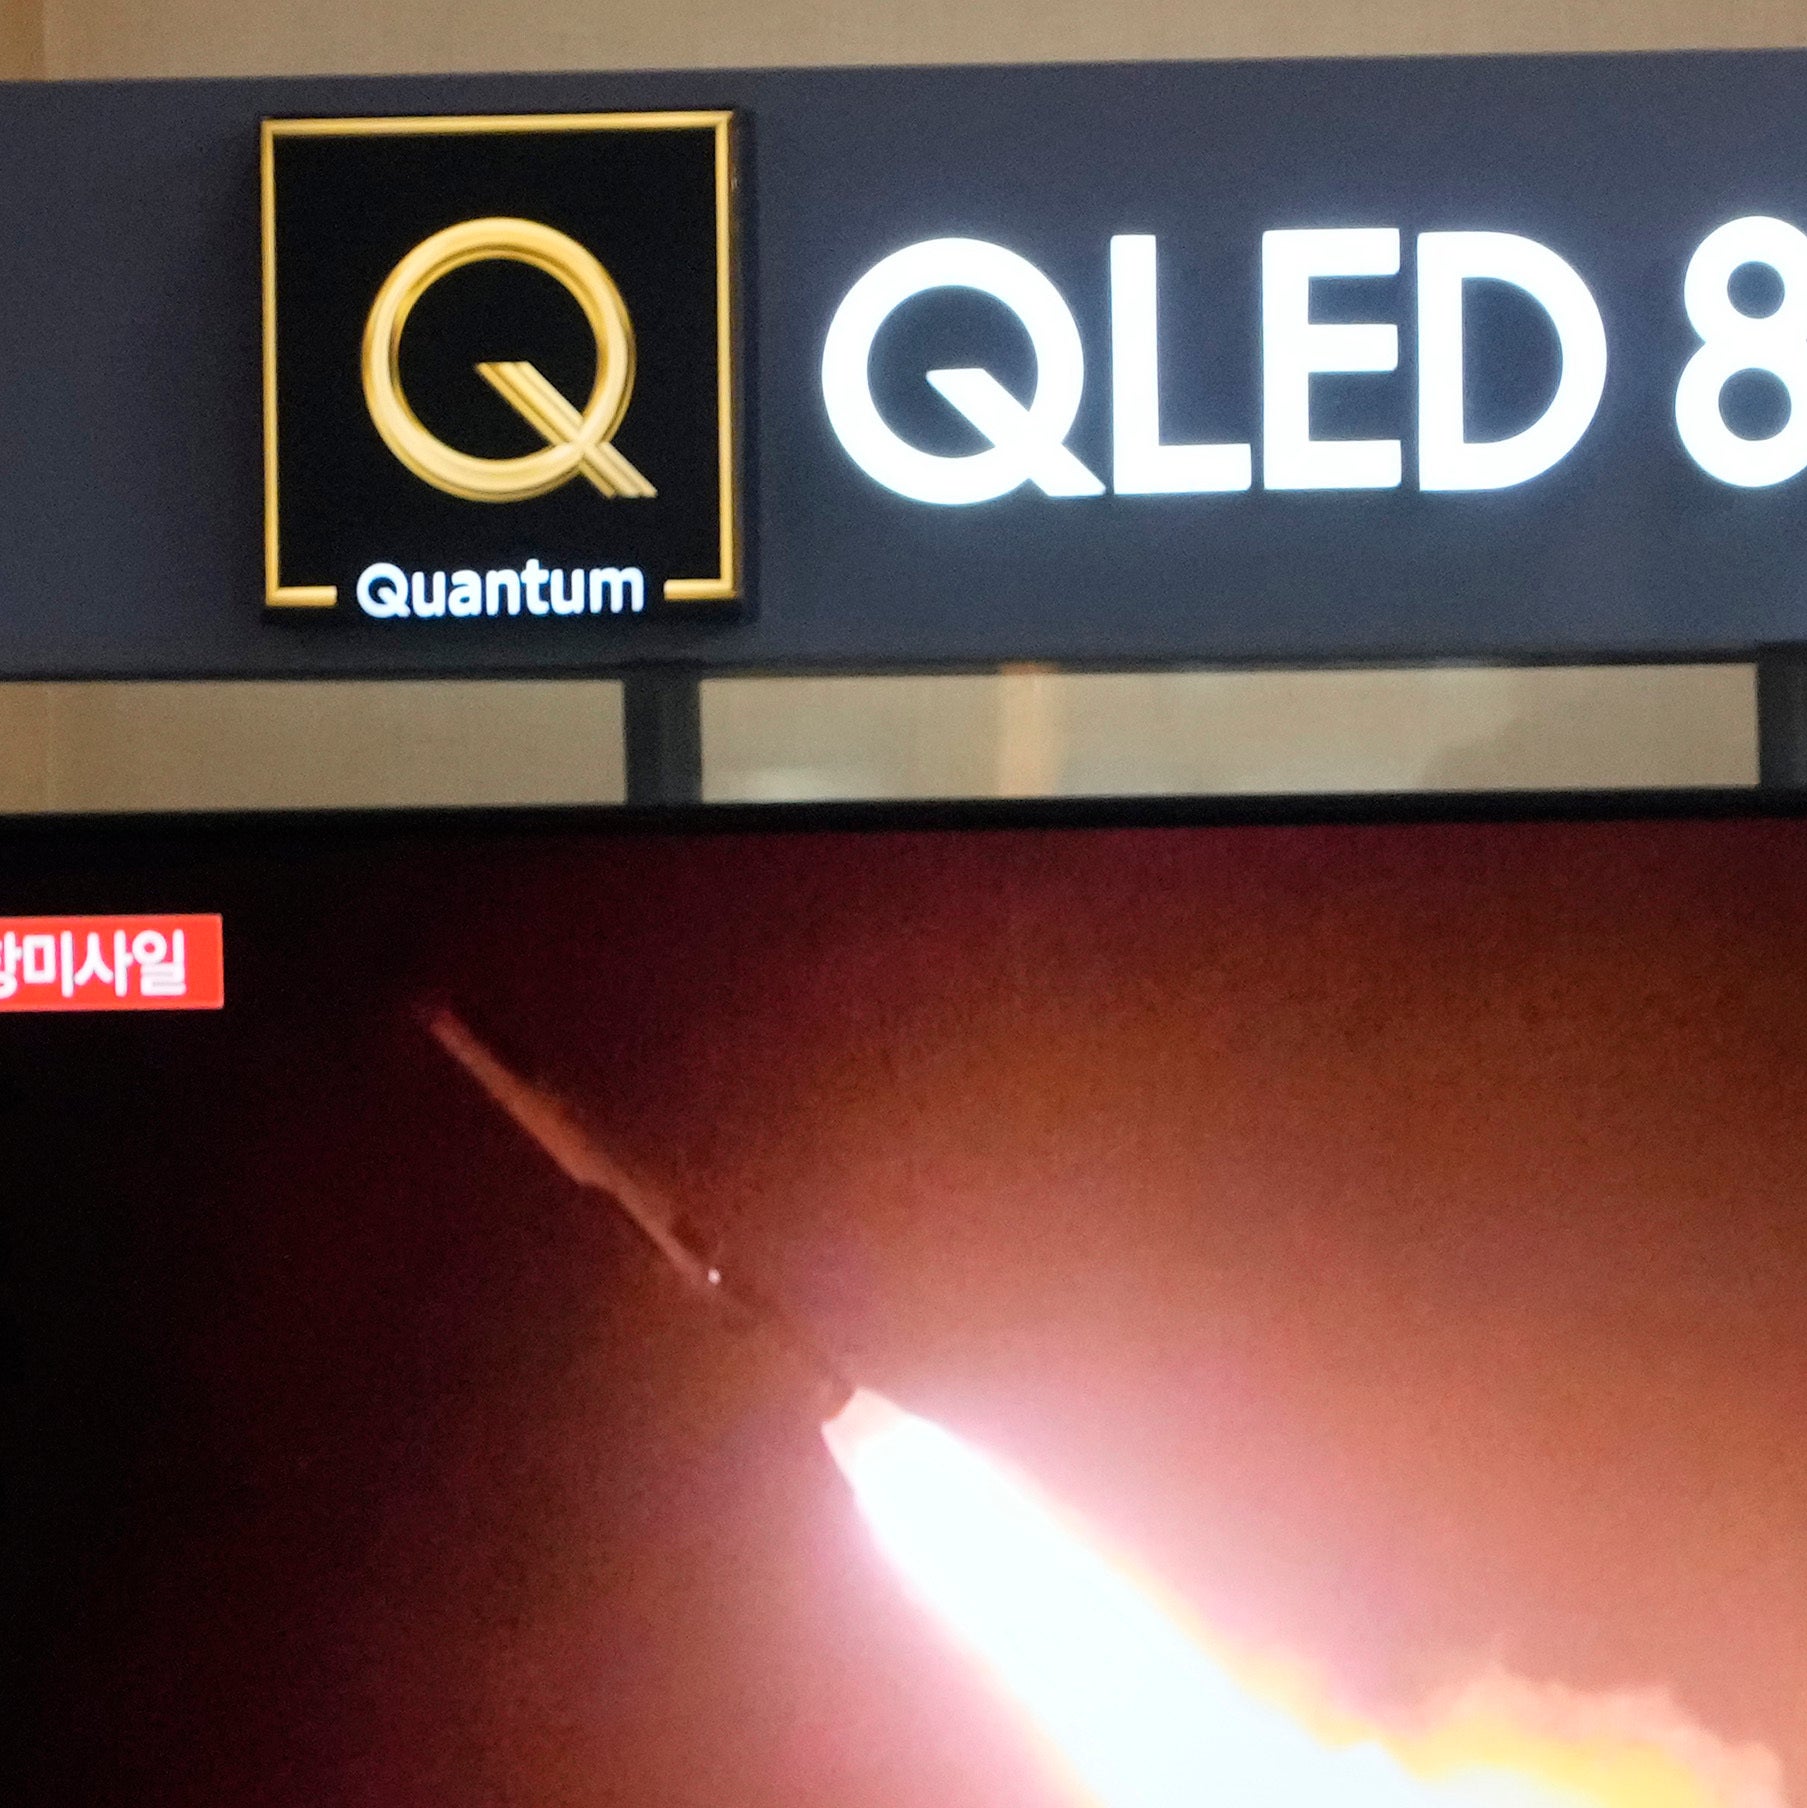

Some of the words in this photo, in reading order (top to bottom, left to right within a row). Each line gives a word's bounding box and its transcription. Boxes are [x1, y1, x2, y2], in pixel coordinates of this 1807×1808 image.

[360, 215, 659, 502] Q
[820, 226, 1609, 506] QLED
[355, 557, 645, 619] Quantum
